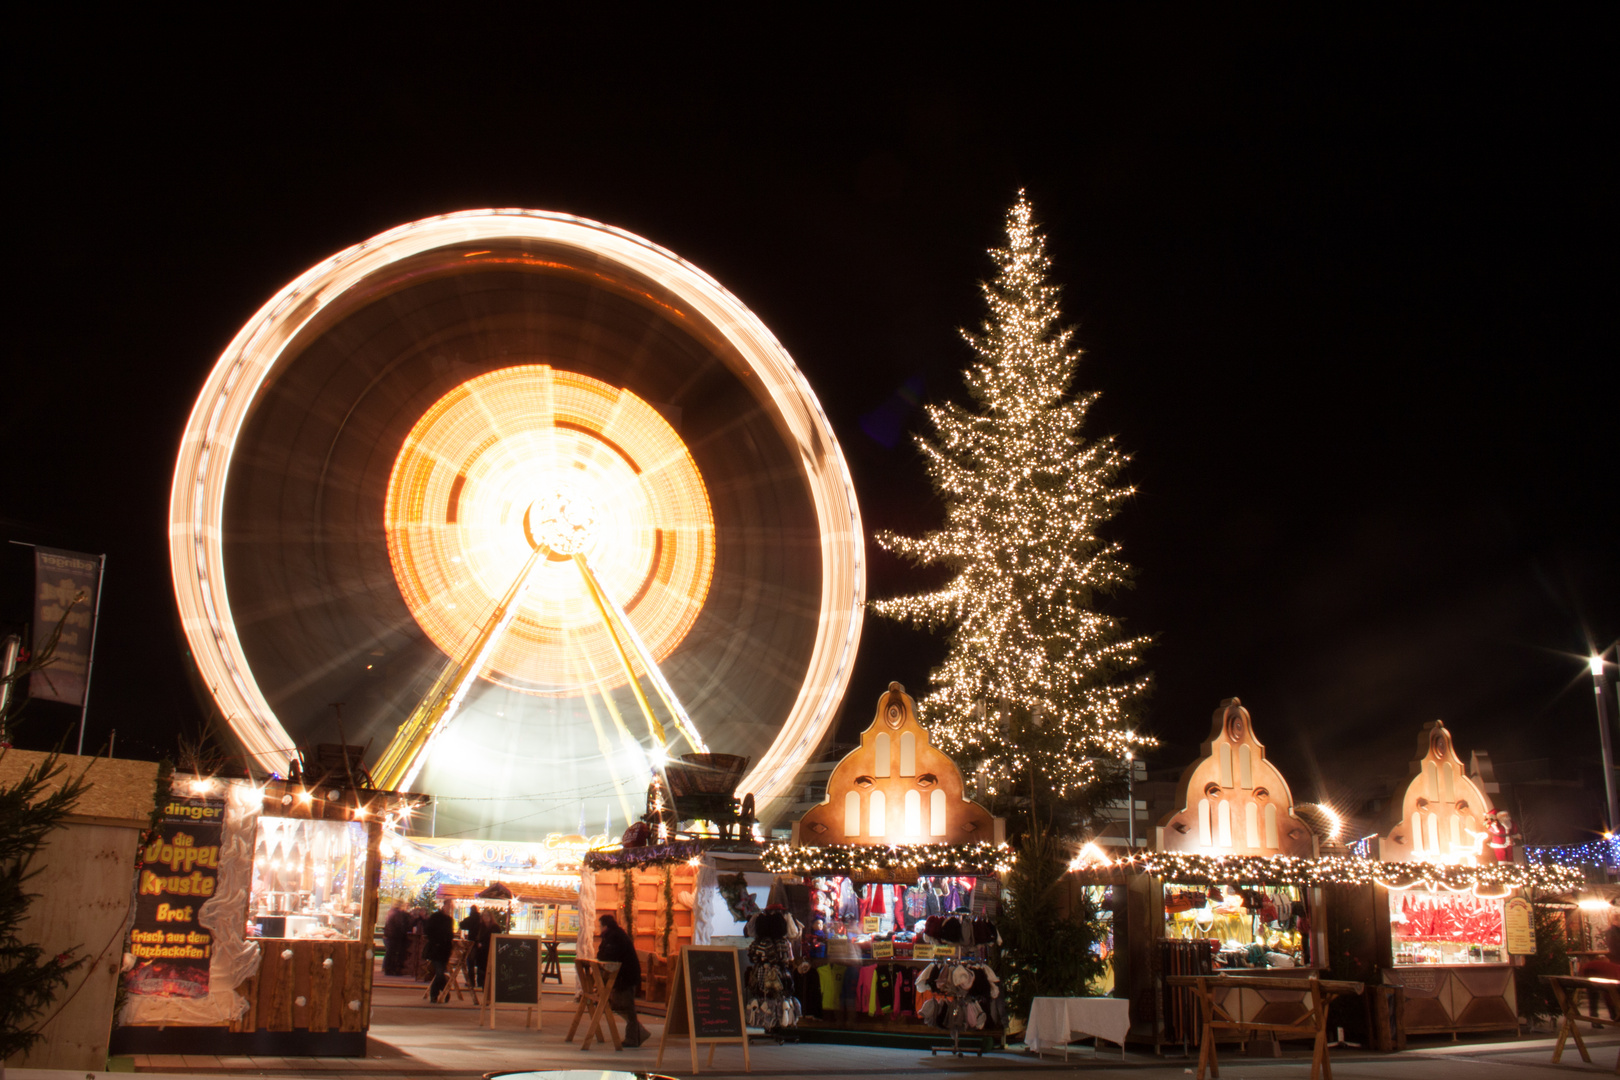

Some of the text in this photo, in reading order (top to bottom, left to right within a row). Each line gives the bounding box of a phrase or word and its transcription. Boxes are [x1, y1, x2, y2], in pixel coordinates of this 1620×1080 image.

[173, 832, 193, 847] die
[156, 903, 193, 922] Brot
[131, 929, 210, 945] frisch aus dem
[131, 944, 210, 959] Holzbackofen !
